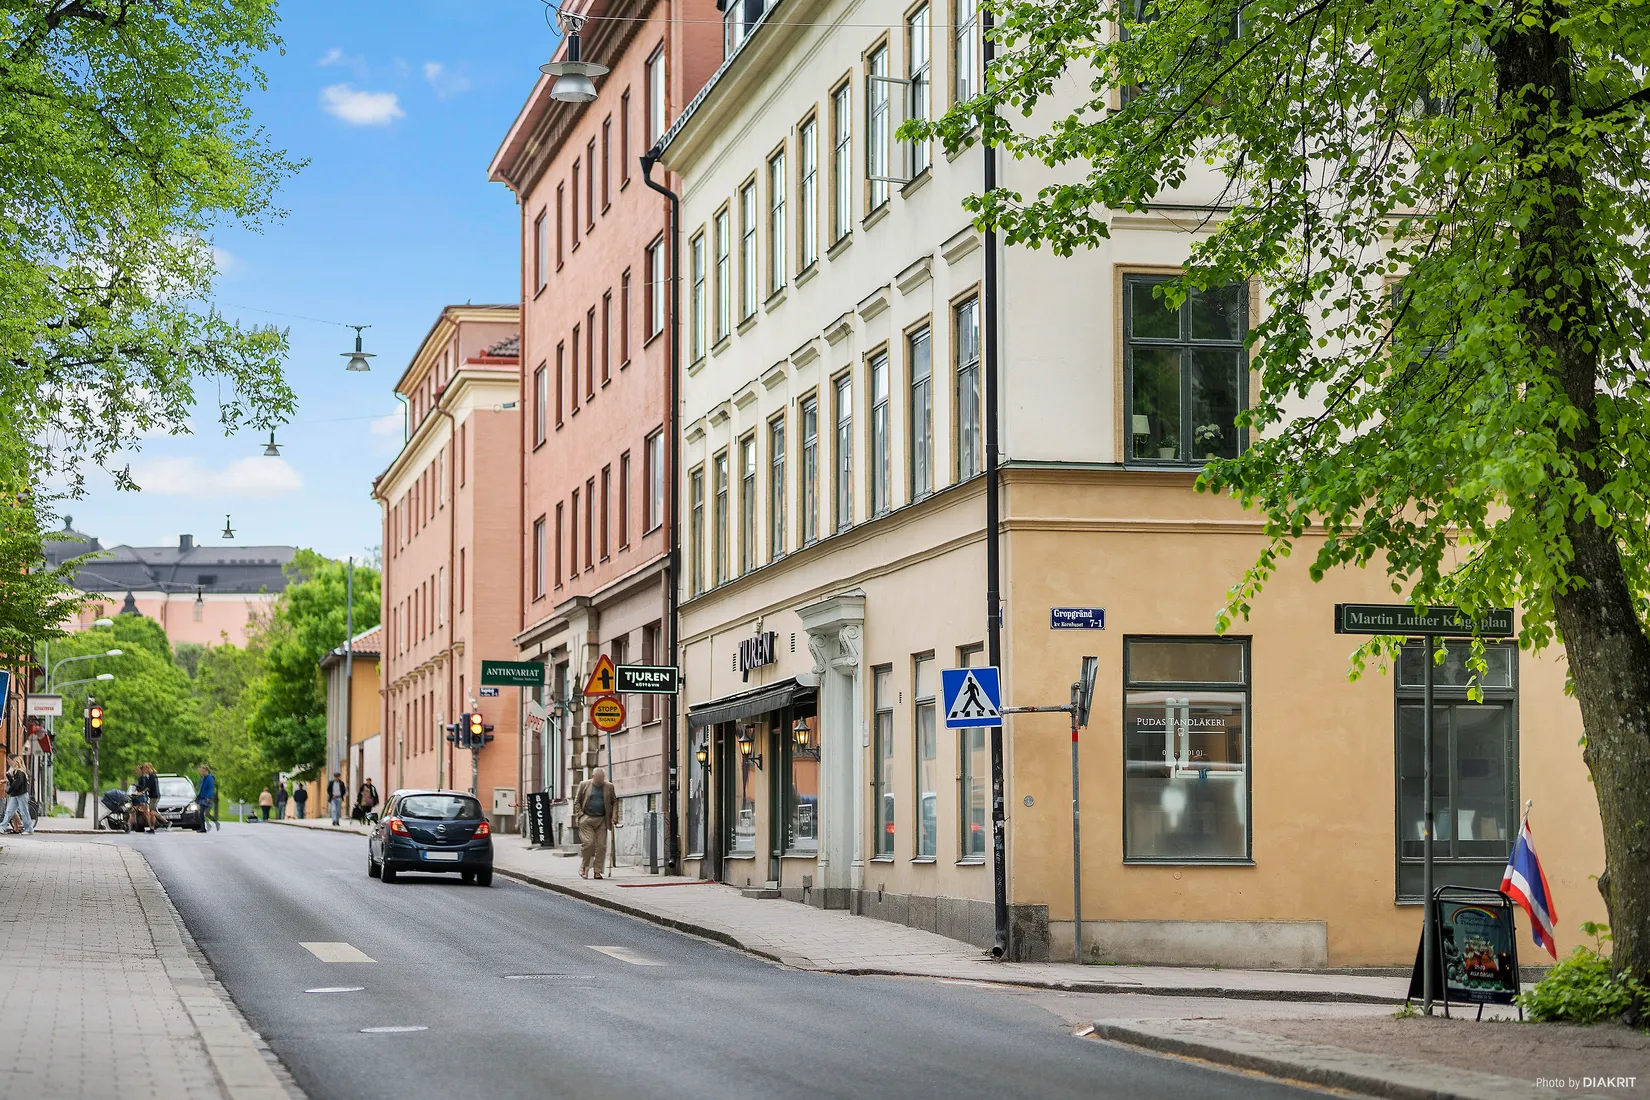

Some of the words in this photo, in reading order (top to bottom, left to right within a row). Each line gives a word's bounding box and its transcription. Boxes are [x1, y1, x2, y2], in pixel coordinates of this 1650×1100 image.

[1054, 609, 1093, 620] Gropgränd
[1090, 619, 1103, 628] 7-1
[1350, 612, 1393, 625] Martin
[1397, 613, 1439, 626] Luther
[1443, 615, 1478, 630] Kngs
[1481, 616, 1507, 630] plan
[738, 631, 775, 682] TJUREN
[486, 667, 540, 678] ANTIKVARIAT
[625, 671, 670, 684] TJUREN
